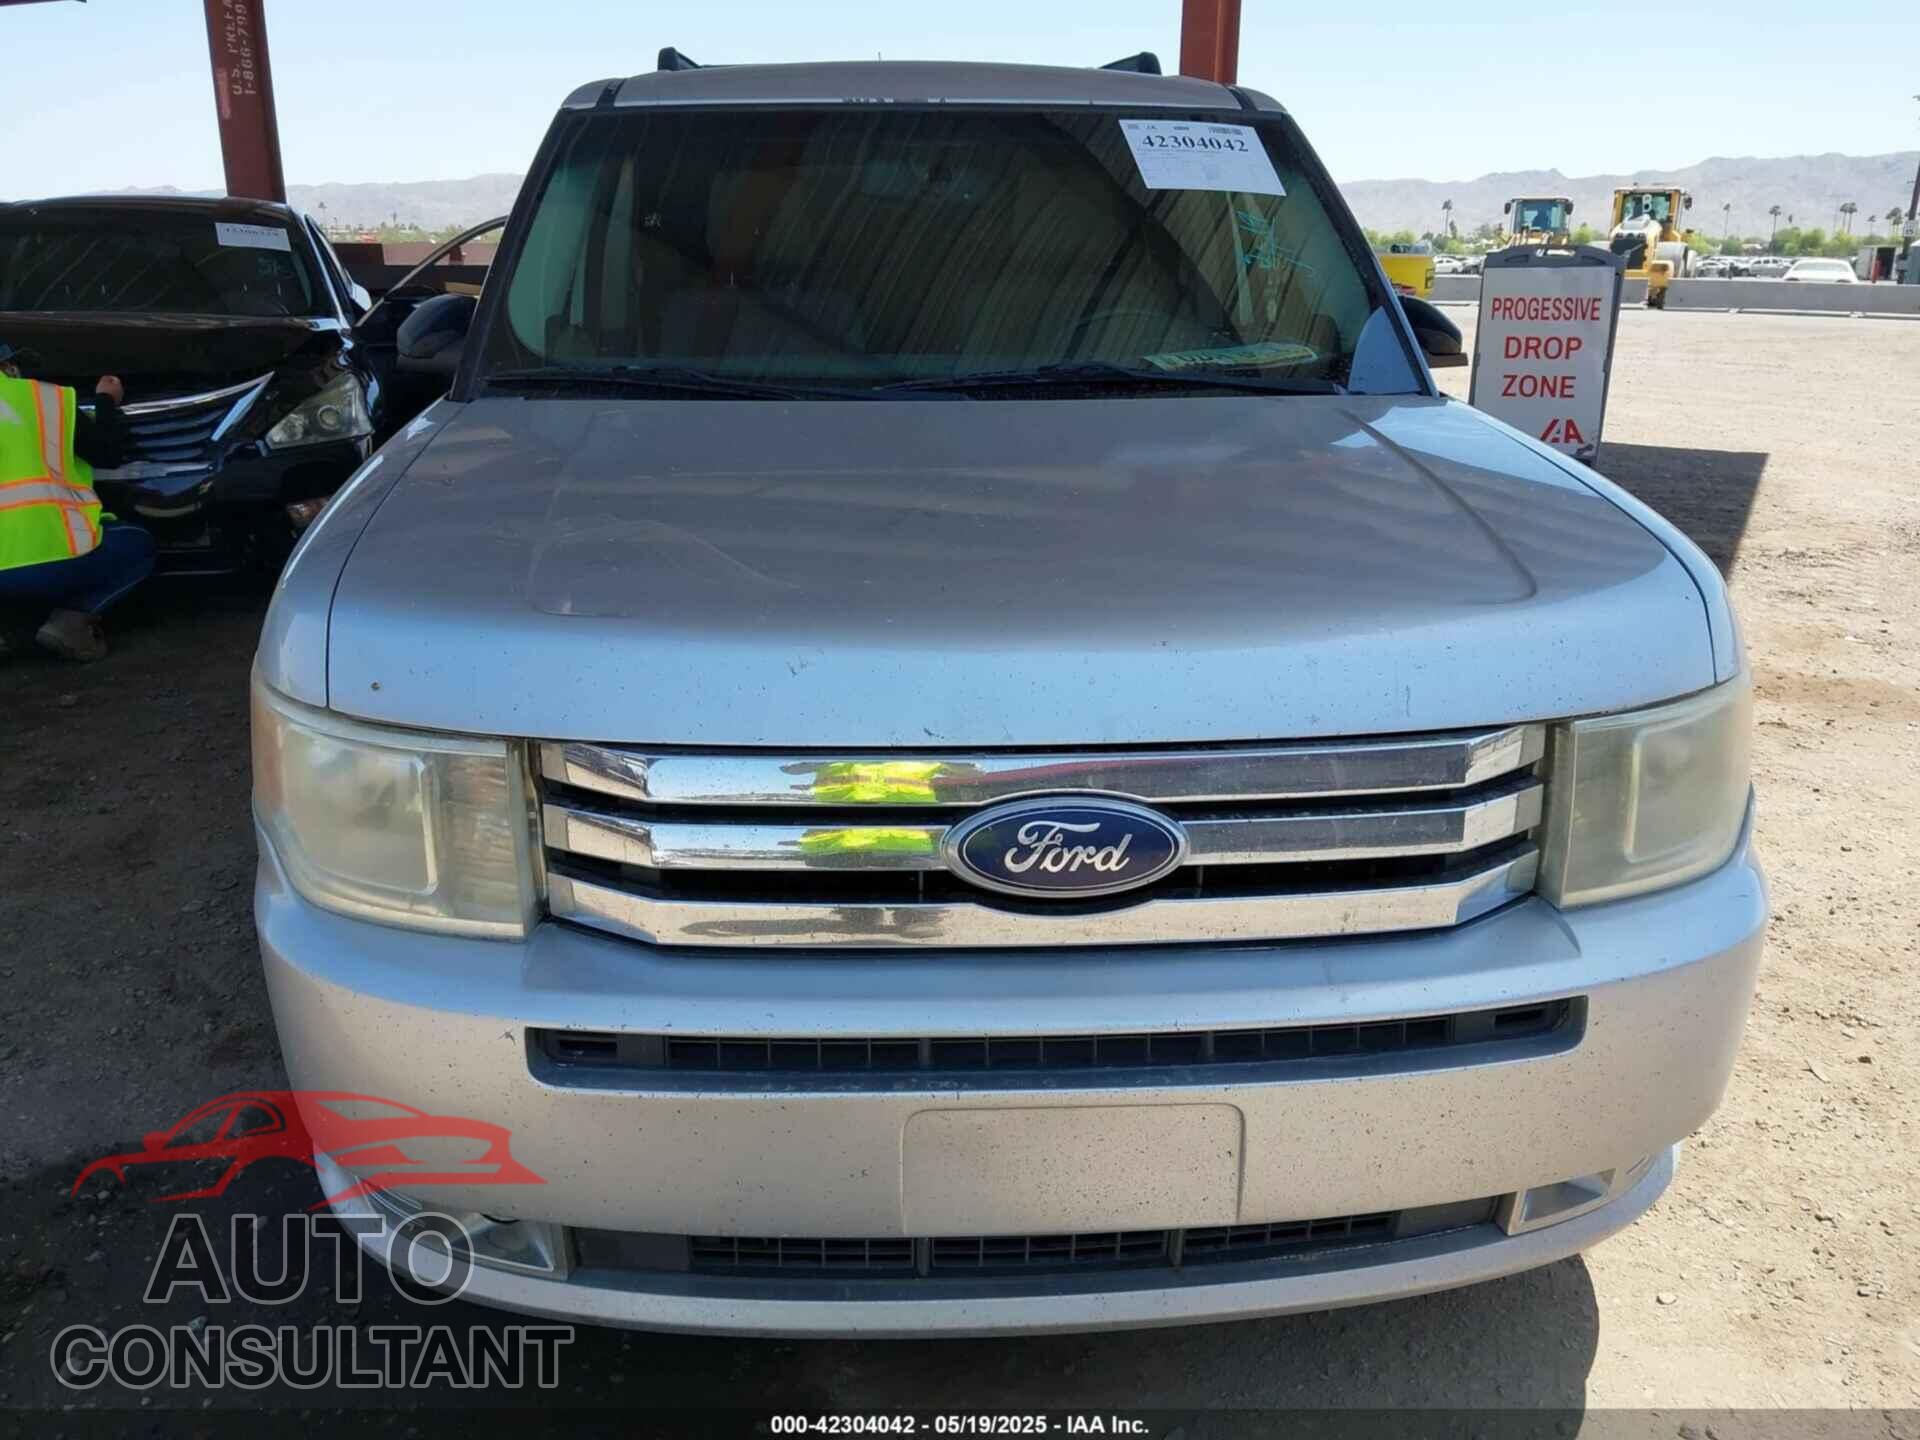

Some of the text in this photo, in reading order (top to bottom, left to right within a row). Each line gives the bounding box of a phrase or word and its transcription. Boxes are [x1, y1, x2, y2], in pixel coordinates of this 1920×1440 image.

[1142, 135, 1249, 152] 42304042
[1491, 297, 1601, 321] PROGESSIVE
[1503, 336, 1582, 360] DROP
[1501, 374, 1576, 398] ZONE
[1004, 820, 1133, 873] Ford
